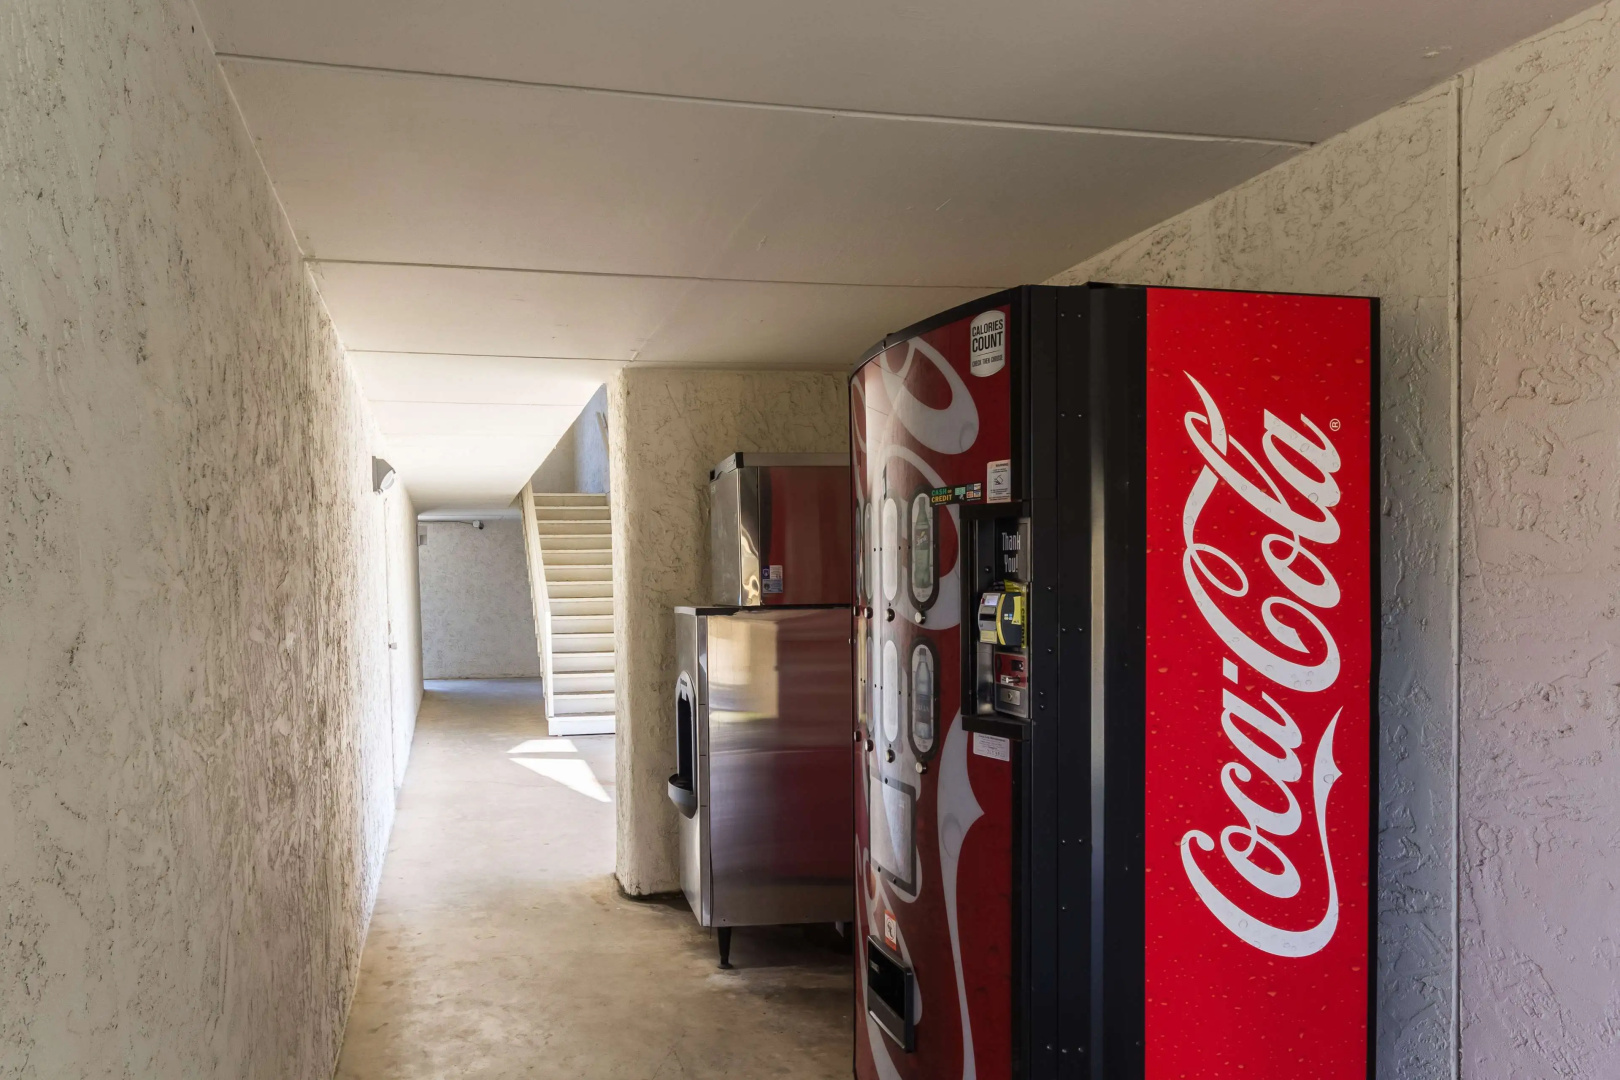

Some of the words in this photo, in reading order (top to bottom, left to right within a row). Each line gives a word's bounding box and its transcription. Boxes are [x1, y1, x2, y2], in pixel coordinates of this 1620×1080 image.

[972, 319, 1004, 337] CALORIES
[972, 331, 1003, 352] COUNT
[931, 488, 947, 496] CASH
[931, 493, 953, 503] CREDIT
[1002, 532, 1021, 551] Thank
[1004, 554, 1019, 573] You!
[1180, 369, 1344, 958] Coca-Cola
